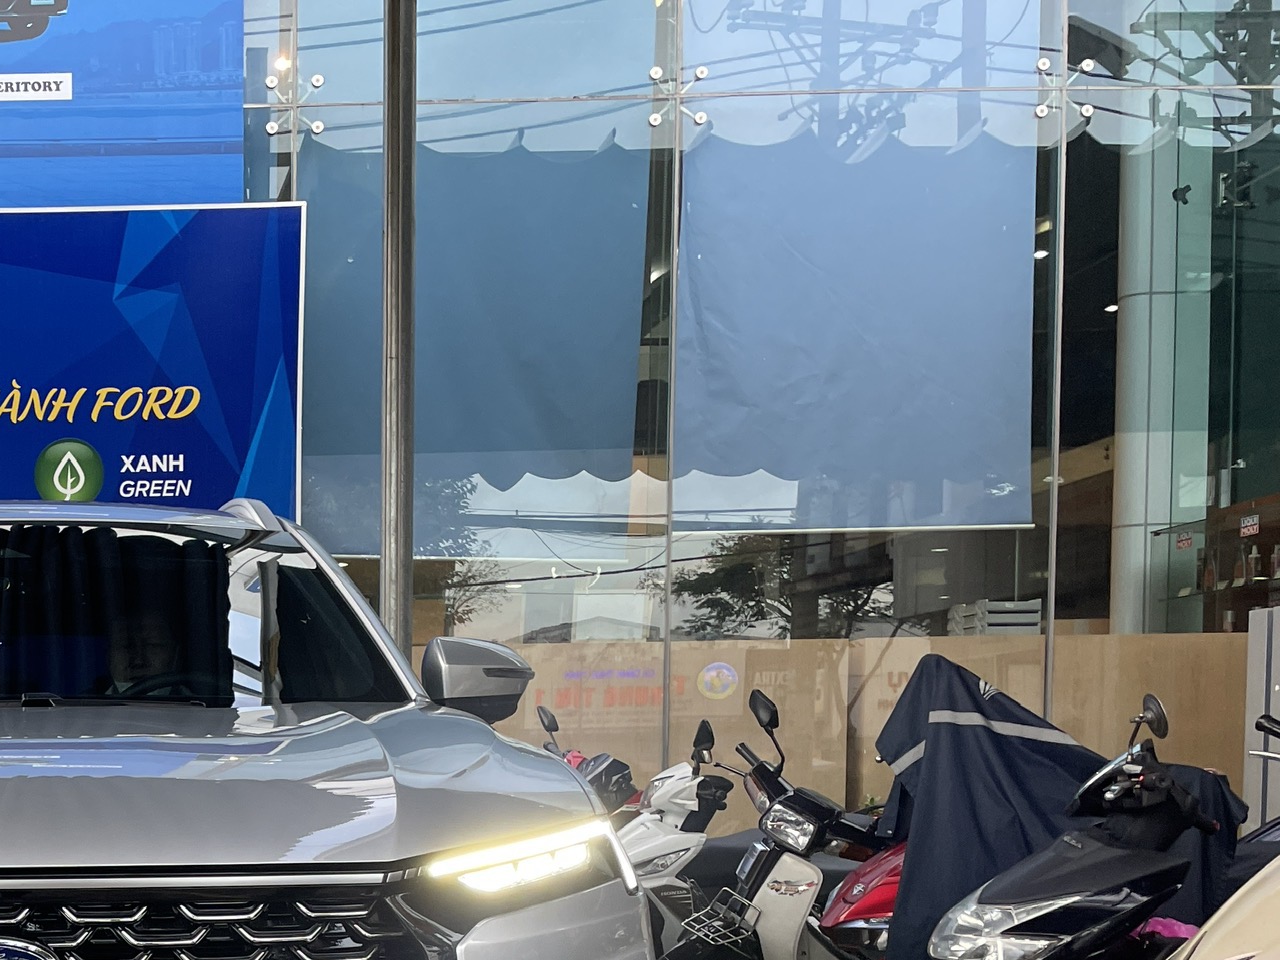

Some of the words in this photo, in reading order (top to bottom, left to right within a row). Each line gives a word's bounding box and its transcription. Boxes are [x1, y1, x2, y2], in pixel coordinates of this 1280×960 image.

[90, 386, 201, 423] FORD
[120, 454, 185, 473] XANH
[119, 480, 192, 498] GREEN
